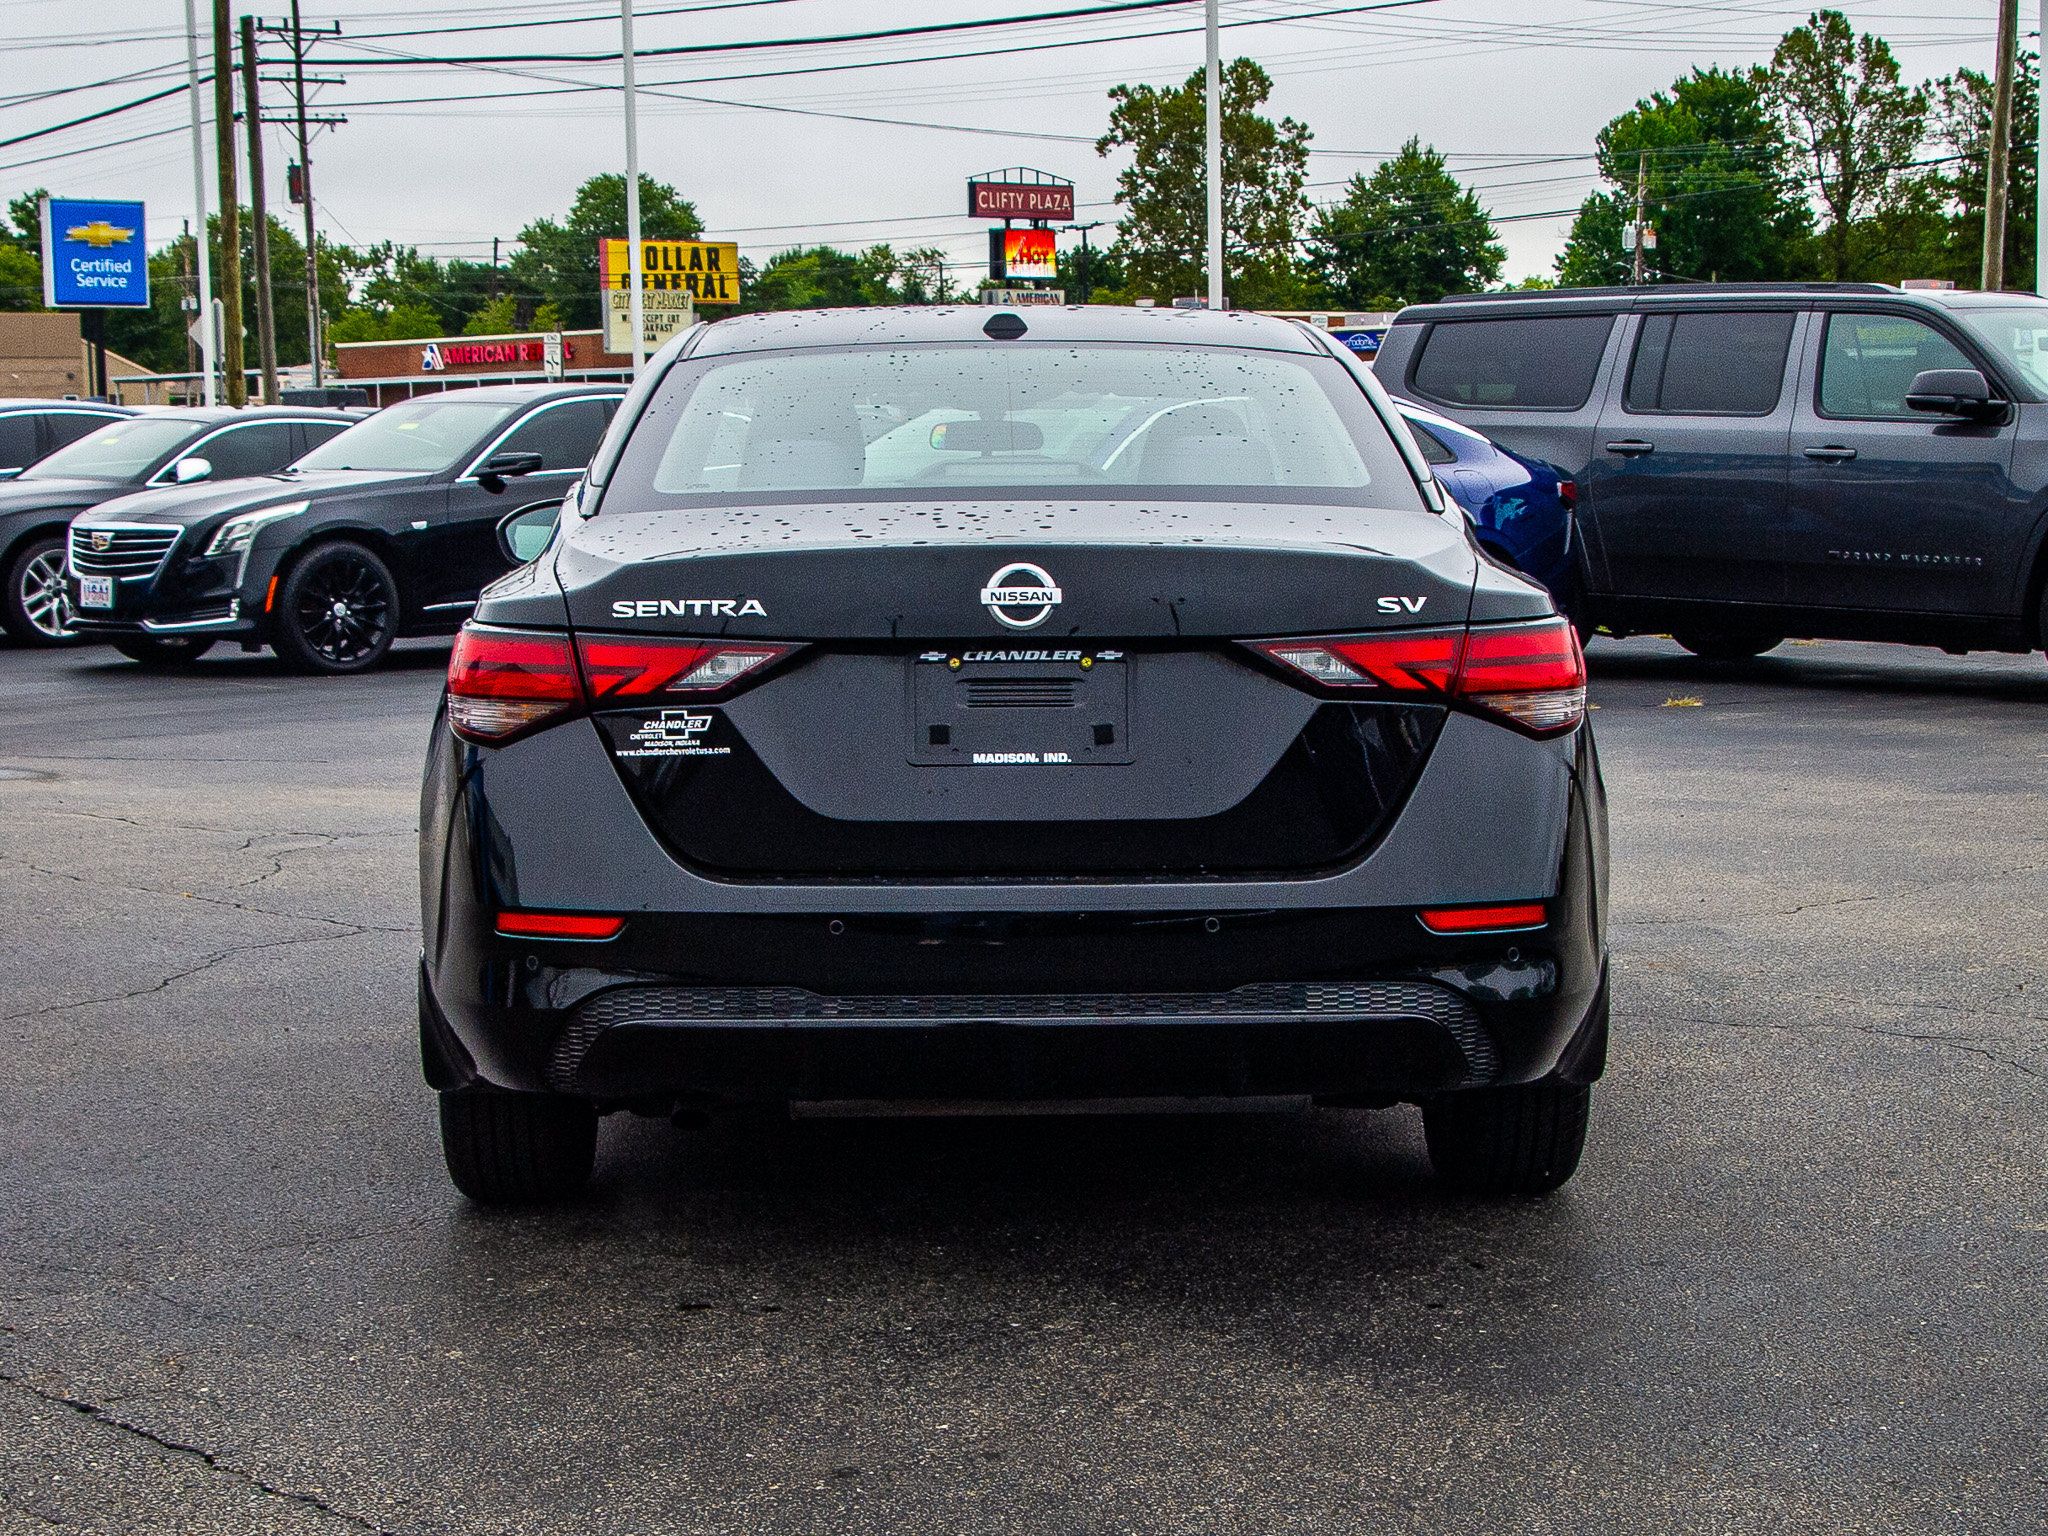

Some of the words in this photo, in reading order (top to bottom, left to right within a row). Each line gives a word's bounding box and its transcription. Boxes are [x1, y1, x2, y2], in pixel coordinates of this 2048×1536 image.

[978, 191, 1024, 209] CLIFTY
[1029, 193, 1071, 211] PLAZA
[70, 258, 132, 273] Certified
[76, 273, 128, 288] Service
[443, 344, 516, 364] AMERICAN
[990, 591, 1053, 602] NISSAN
[611, 599, 768, 618] SENTRA
[1377, 596, 1428, 614] SV
[962, 650, 1082, 661] CHANDLER
[643, 719, 703, 730] CHANDLER
[616, 747, 731, 757] www.chandlerchevroletusa.com
[1043, 752, 1073, 763] IND.
